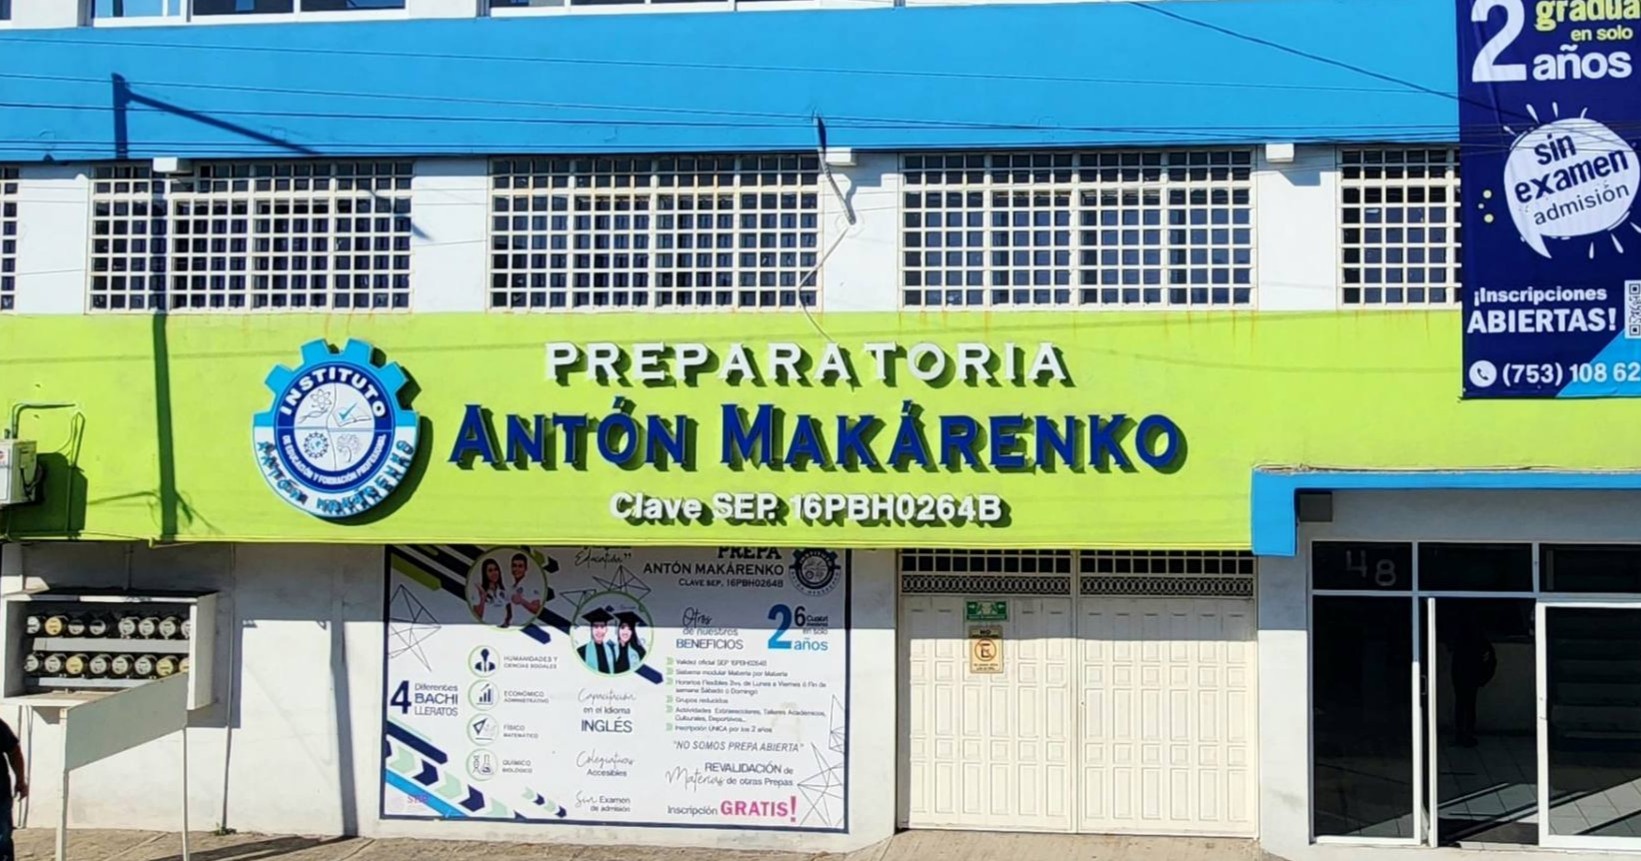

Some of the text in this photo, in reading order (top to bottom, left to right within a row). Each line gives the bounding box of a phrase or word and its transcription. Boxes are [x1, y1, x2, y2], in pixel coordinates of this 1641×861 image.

[1471, 0, 1527, 82] 2
[1571, 25, 1633, 41] en solo
[1533, 44, 1632, 81] años
[1534, 133, 1576, 165] sin
[1514, 150, 1629, 203] examen
[1533, 182, 1630, 225] admisión
[1474, 286, 1608, 306] ¡Inscripciones
[1467, 308, 1617, 334] ABIERTAS!
[544, 341, 1067, 380] PREPARATORIA
[1502, 363, 1641, 387] (753) 108 62
[280, 367, 386, 417] INSTITUTO
[447, 396, 1179, 468] ANTÓN MAKÁRENKO
[610, 492, 1001, 521] Clave SEP. 16PBH0264B
[643, 561, 784, 576] ANTÓN MAKÁRENKO
[768, 603, 806, 649] 2 6
[676, 639, 744, 650] BENEFICIOS
[794, 637, 828, 651] años
[390, 680, 412, 715] 4
[415, 683, 458, 692] Diferentes
[415, 693, 458, 704] BACHI
[415, 706, 458, 716] LLERATOS
[581, 716, 633, 733] INGLÉS
[692, 741, 726, 751] SOMOS
[728, 742, 758, 751] PREPA
[705, 760, 794, 775] REVALIDACIÓN de
[726, 776, 737, 785] de
[764, 777, 793, 789] Prepas
[667, 796, 797, 823] Inscripción GRATIS!
